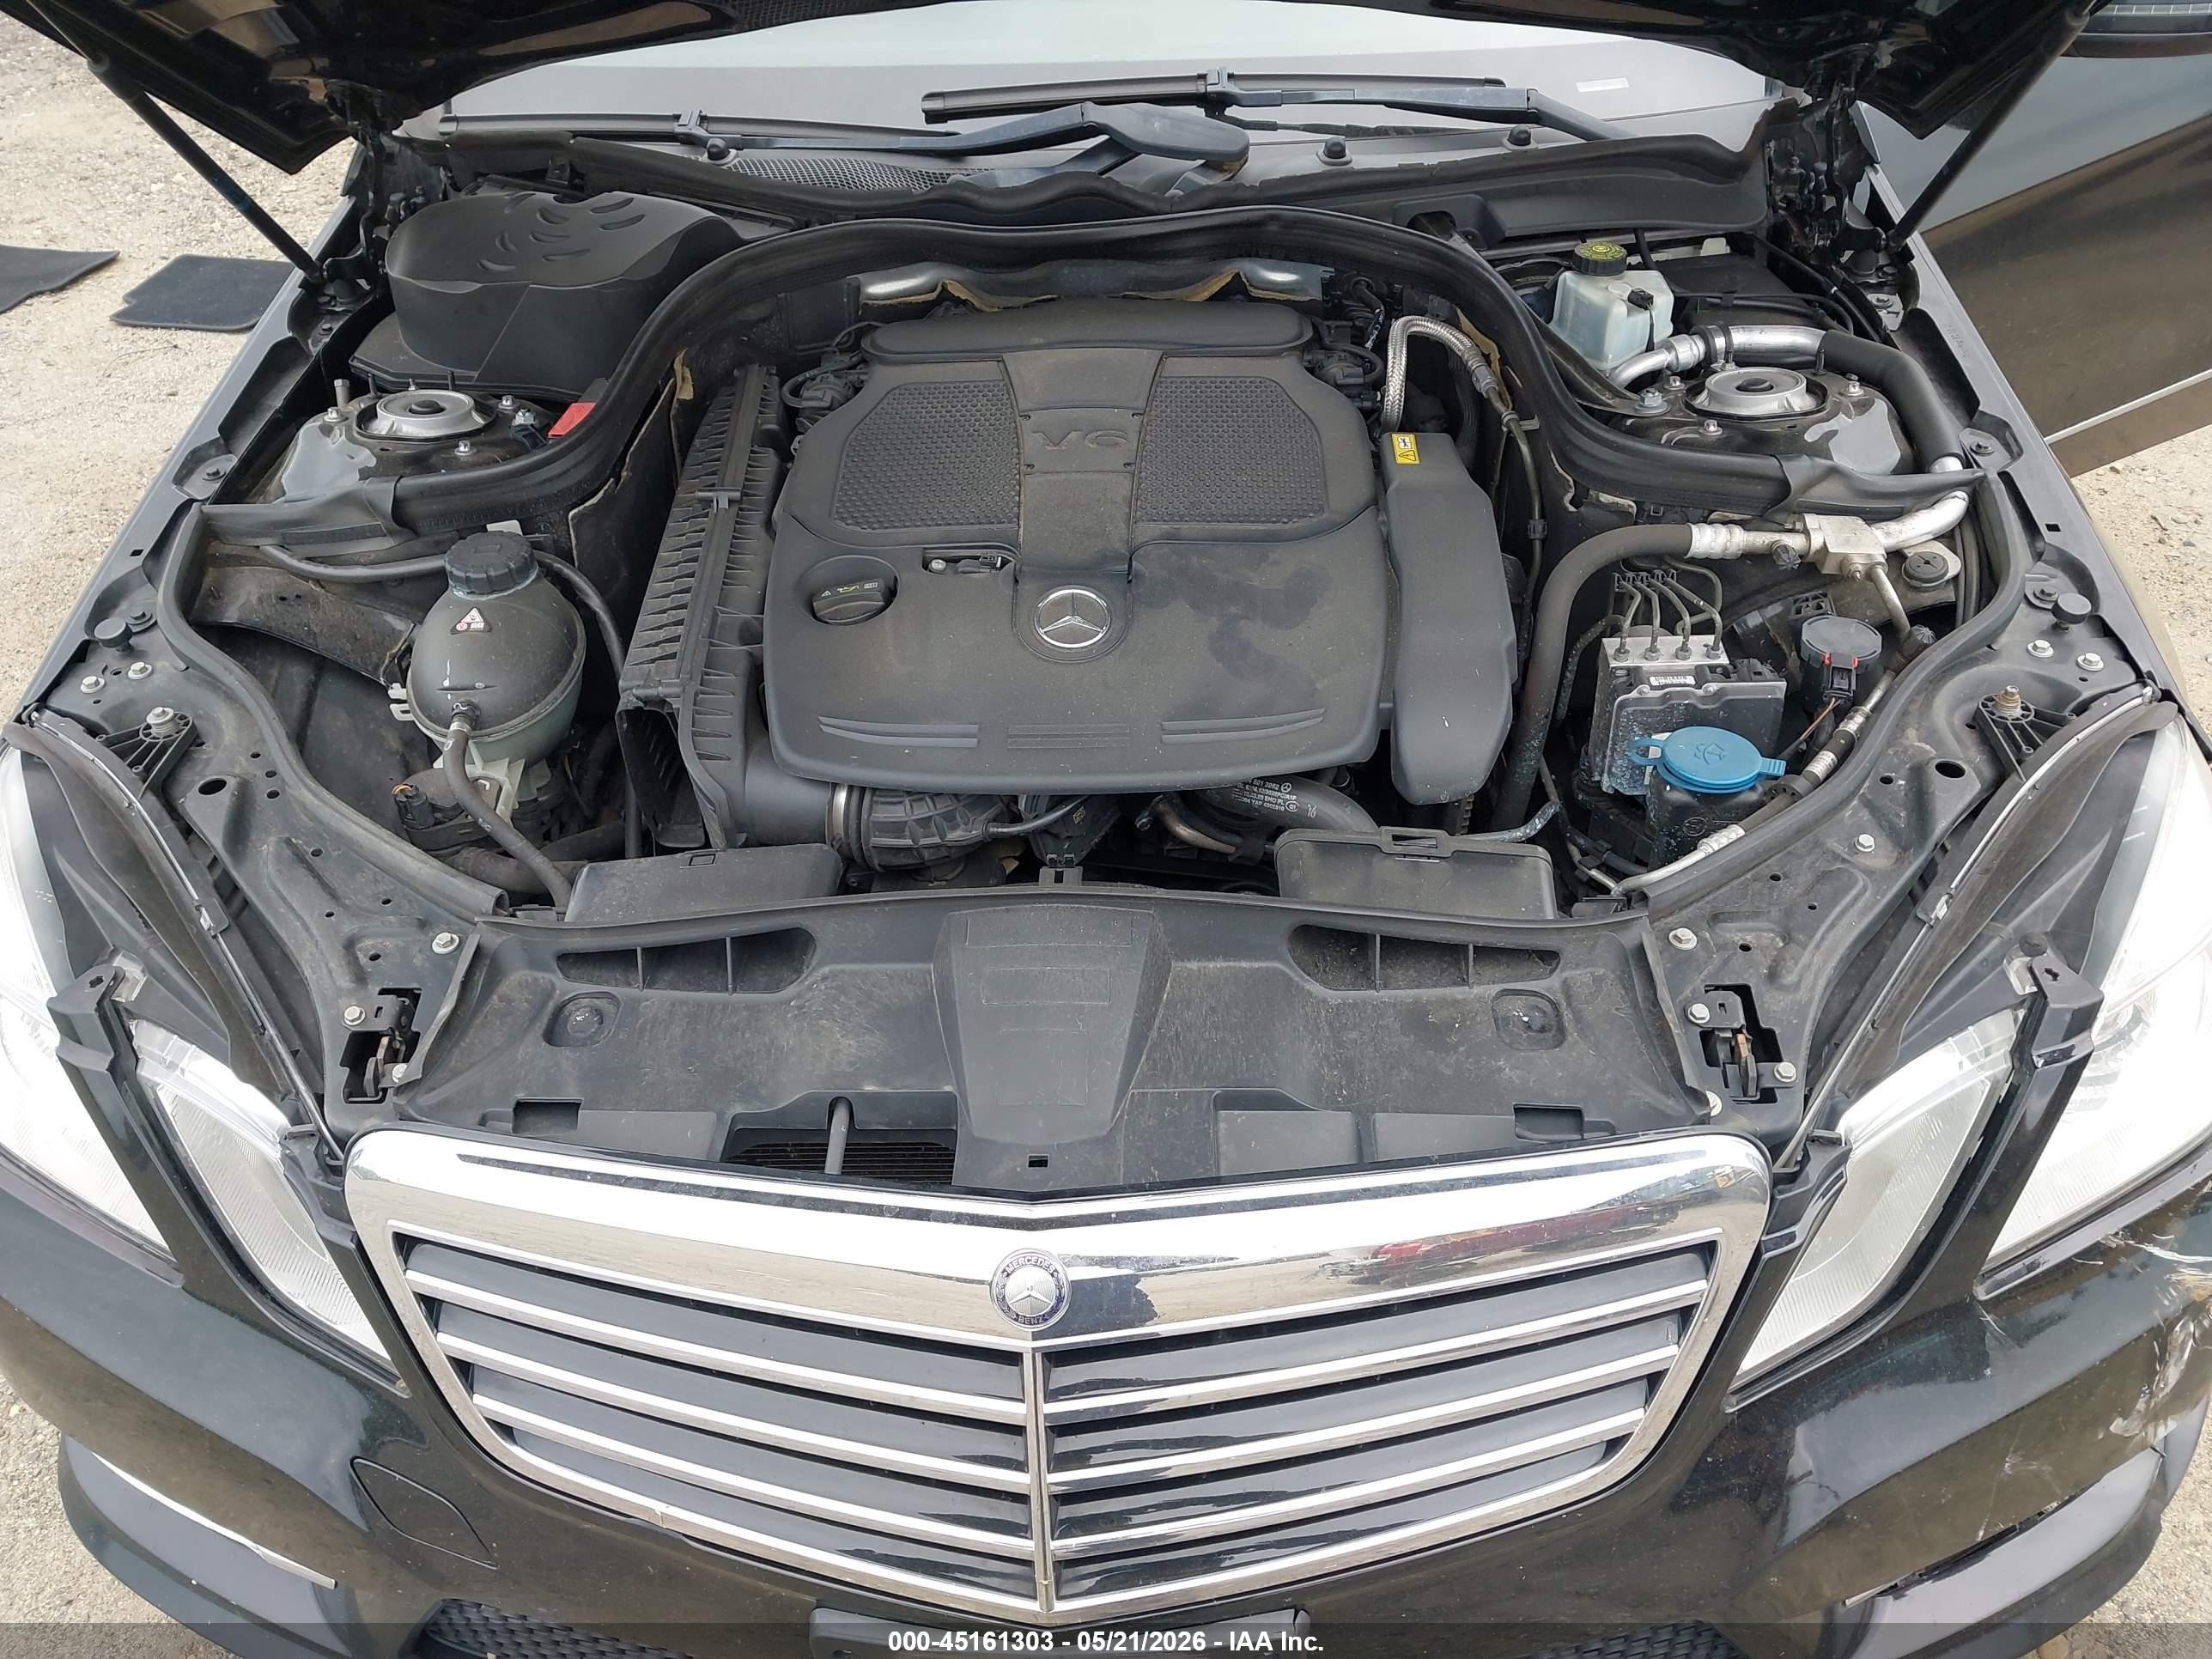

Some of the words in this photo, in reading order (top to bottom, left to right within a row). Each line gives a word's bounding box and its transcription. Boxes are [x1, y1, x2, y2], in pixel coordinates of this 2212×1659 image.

[1031, 428, 1127, 450] V6
[1005, 1256, 1055, 1273] MERCEDES
[1018, 1316, 1045, 1325] BENZ
